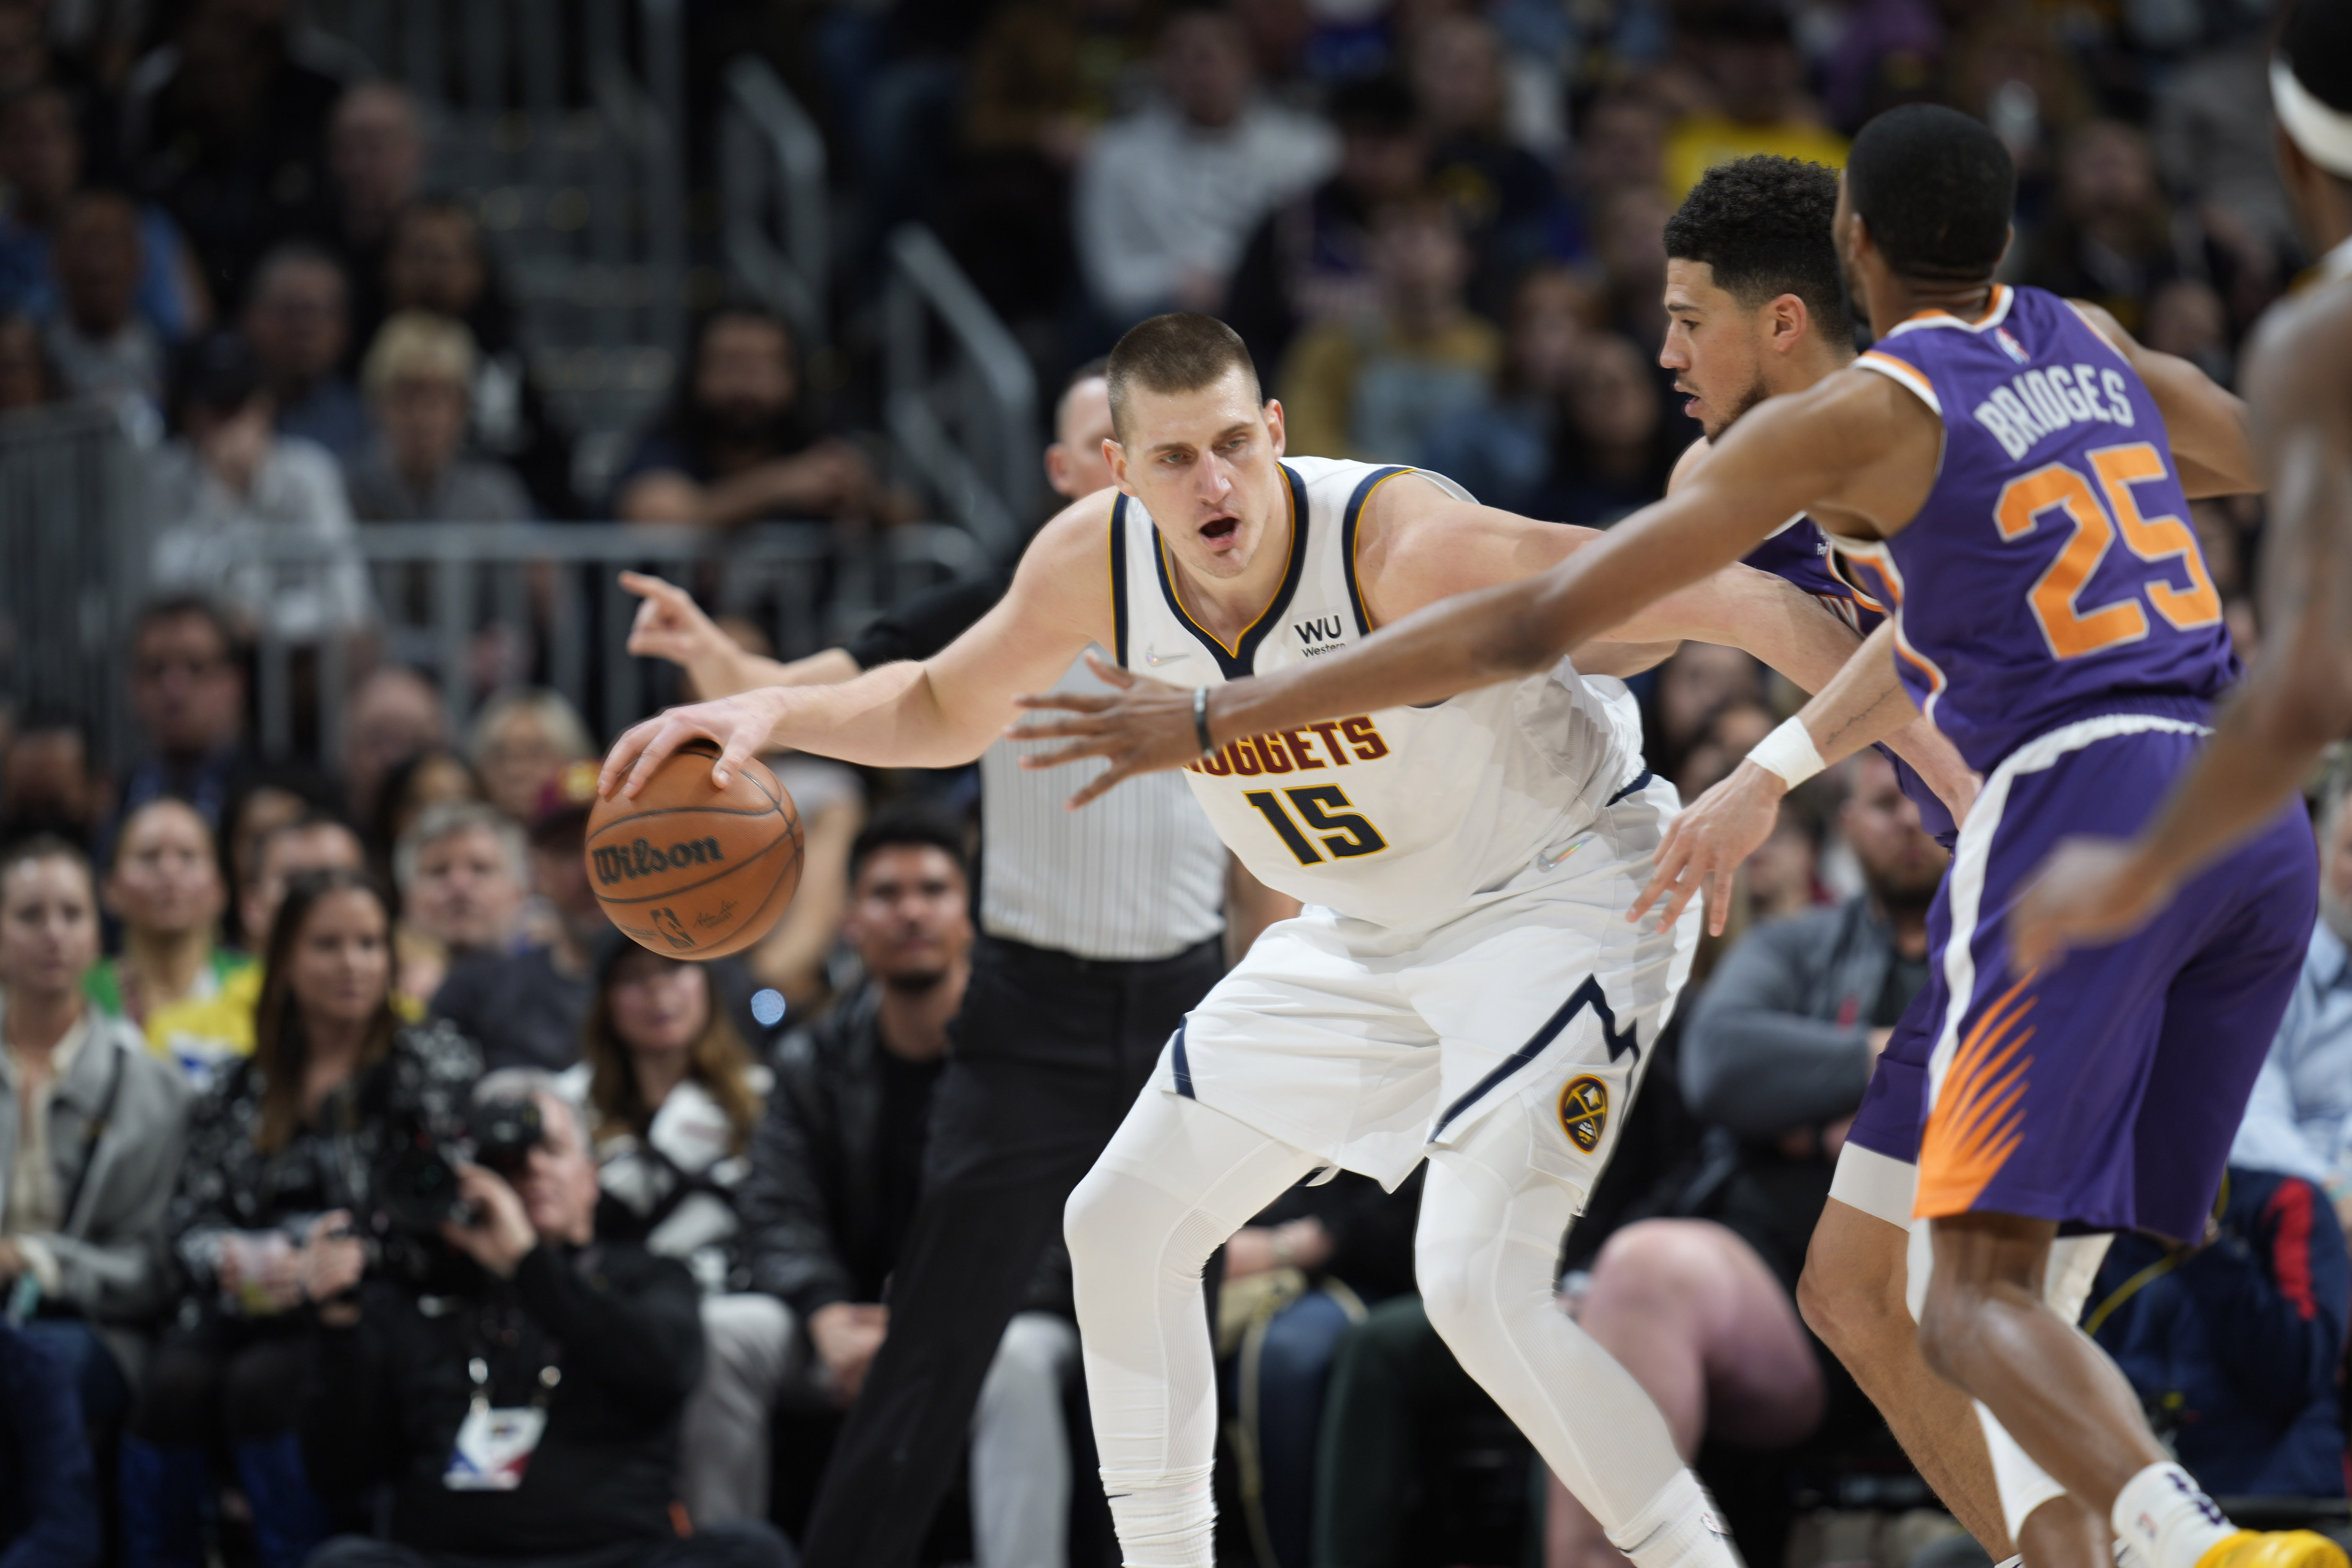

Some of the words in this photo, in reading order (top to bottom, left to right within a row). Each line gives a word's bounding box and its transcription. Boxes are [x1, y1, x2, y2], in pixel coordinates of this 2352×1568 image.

[1973, 363, 2135, 462] BRIDGES
[1992, 441, 2223, 661] 25
[1294, 615, 1341, 644] WU
[1302, 643, 1346, 657] Western
[1182, 714, 1390, 777] UGGETS
[1241, 782, 1390, 867] 15
[592, 836, 724, 886] Wilson
